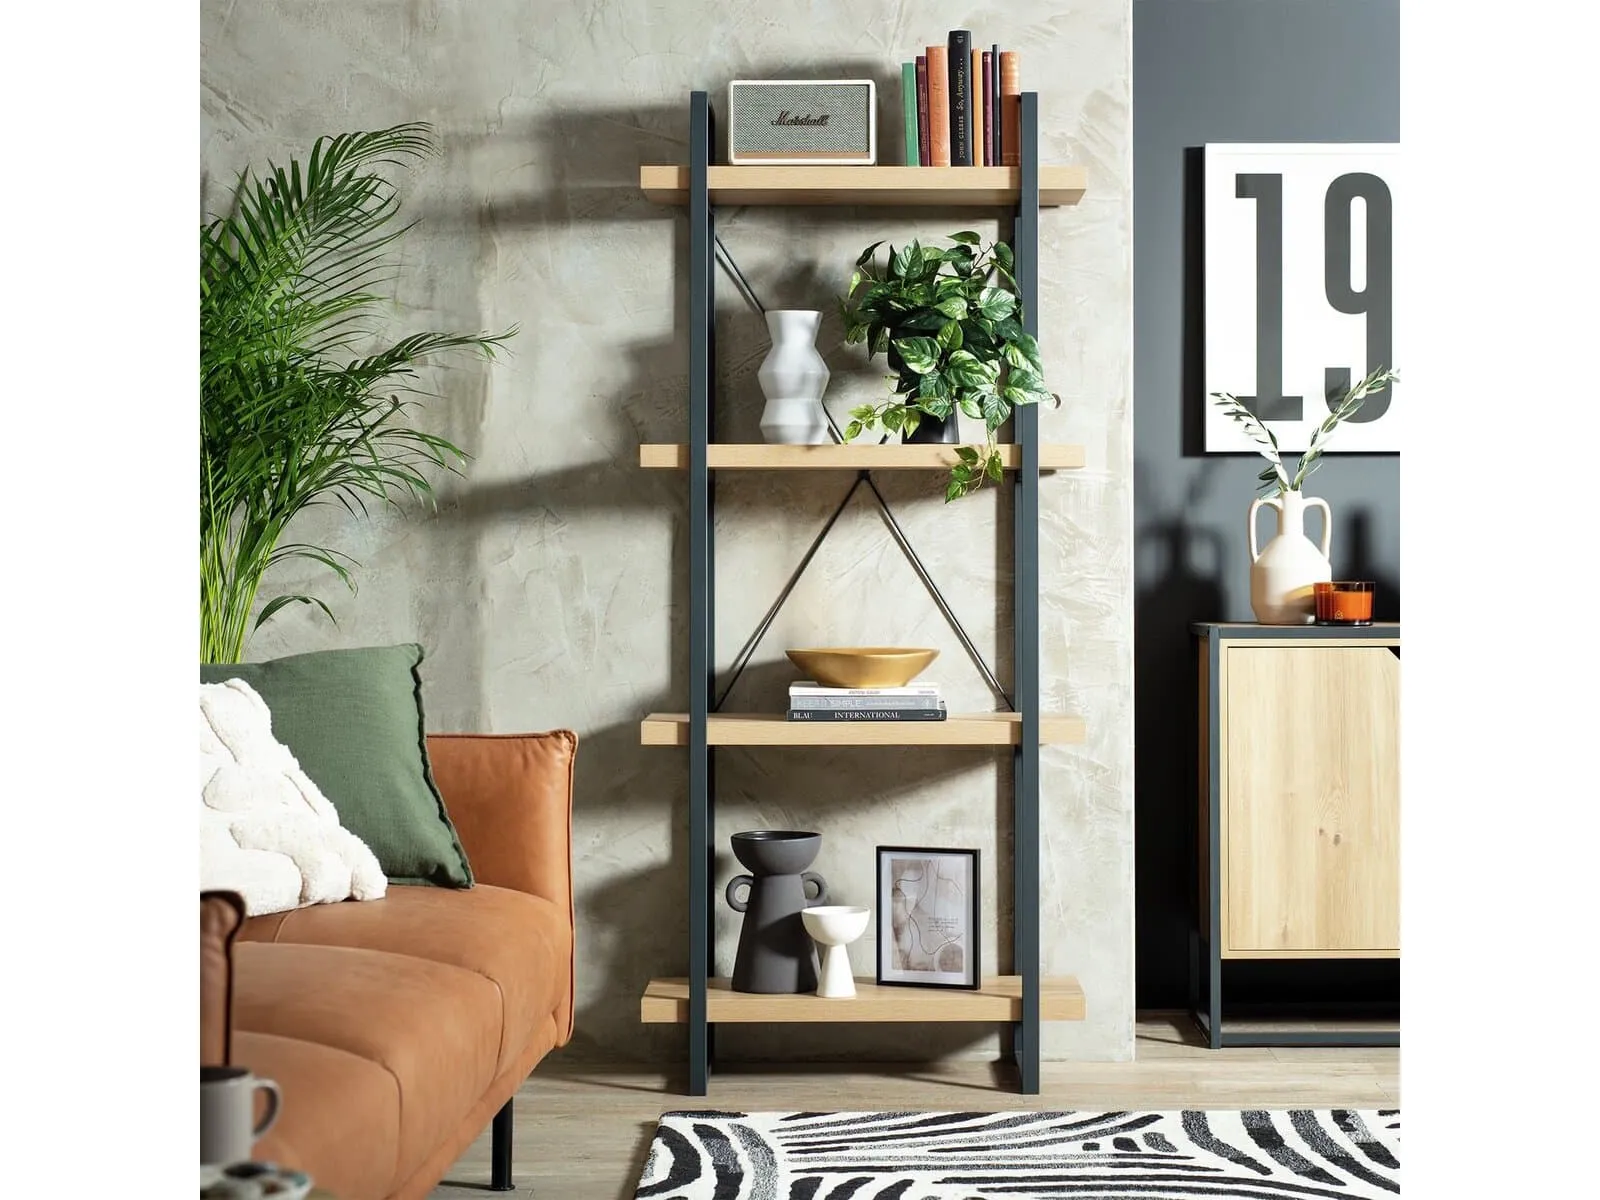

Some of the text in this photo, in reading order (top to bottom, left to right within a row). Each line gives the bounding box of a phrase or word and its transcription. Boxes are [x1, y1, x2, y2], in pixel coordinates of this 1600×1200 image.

[771, 109, 831, 127] Marshall
[1235, 172, 1393, 423] 19
[834, 711, 900, 719] INTERNATIONAL
